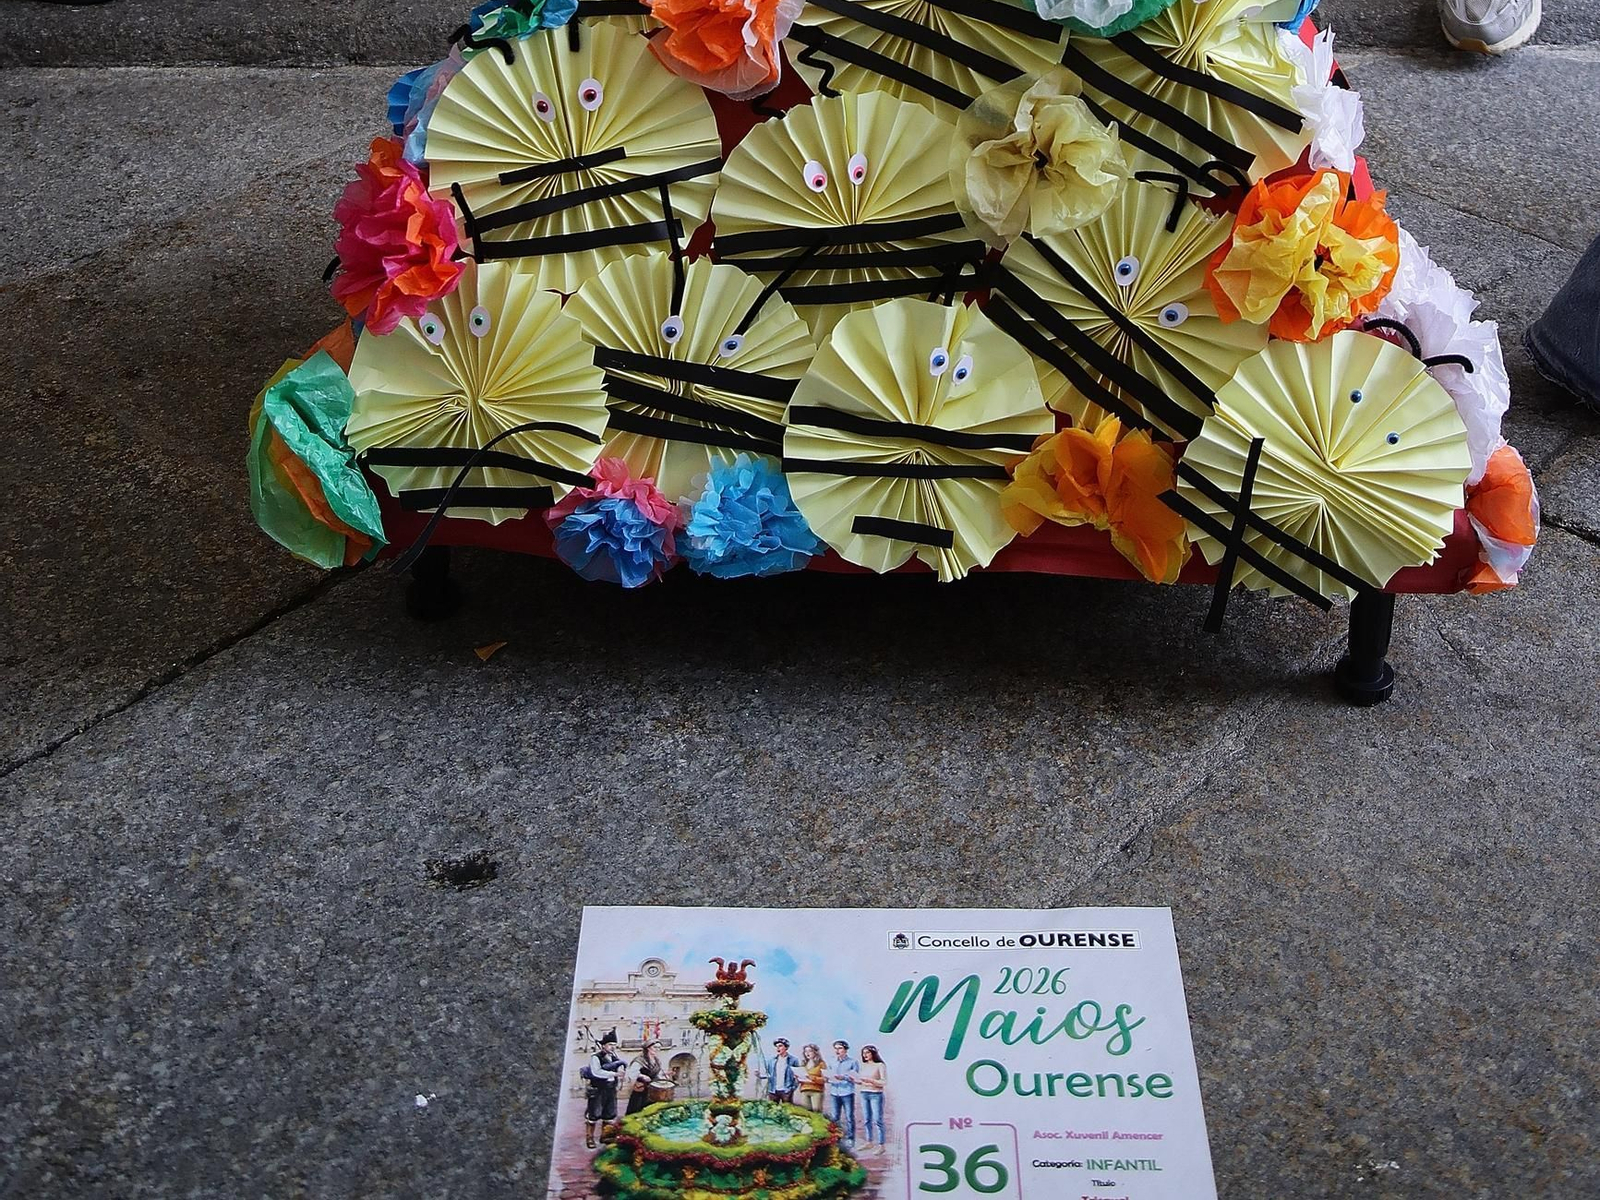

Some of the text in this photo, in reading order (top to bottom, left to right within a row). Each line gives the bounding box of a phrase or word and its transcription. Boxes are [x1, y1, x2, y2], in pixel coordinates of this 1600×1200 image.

[917, 933, 1136, 949] Concello de OURENSE
[993, 966, 1071, 995] 2026
[878, 974, 1147, 1061] Maios
[966, 1059, 1174, 1099] Ourense
[1033, 1130, 1164, 1141] Asoc. Xuvenil Amencer
[918, 1143, 1010, 1194] 36
[1086, 1159, 1163, 1171] INFANTIL
